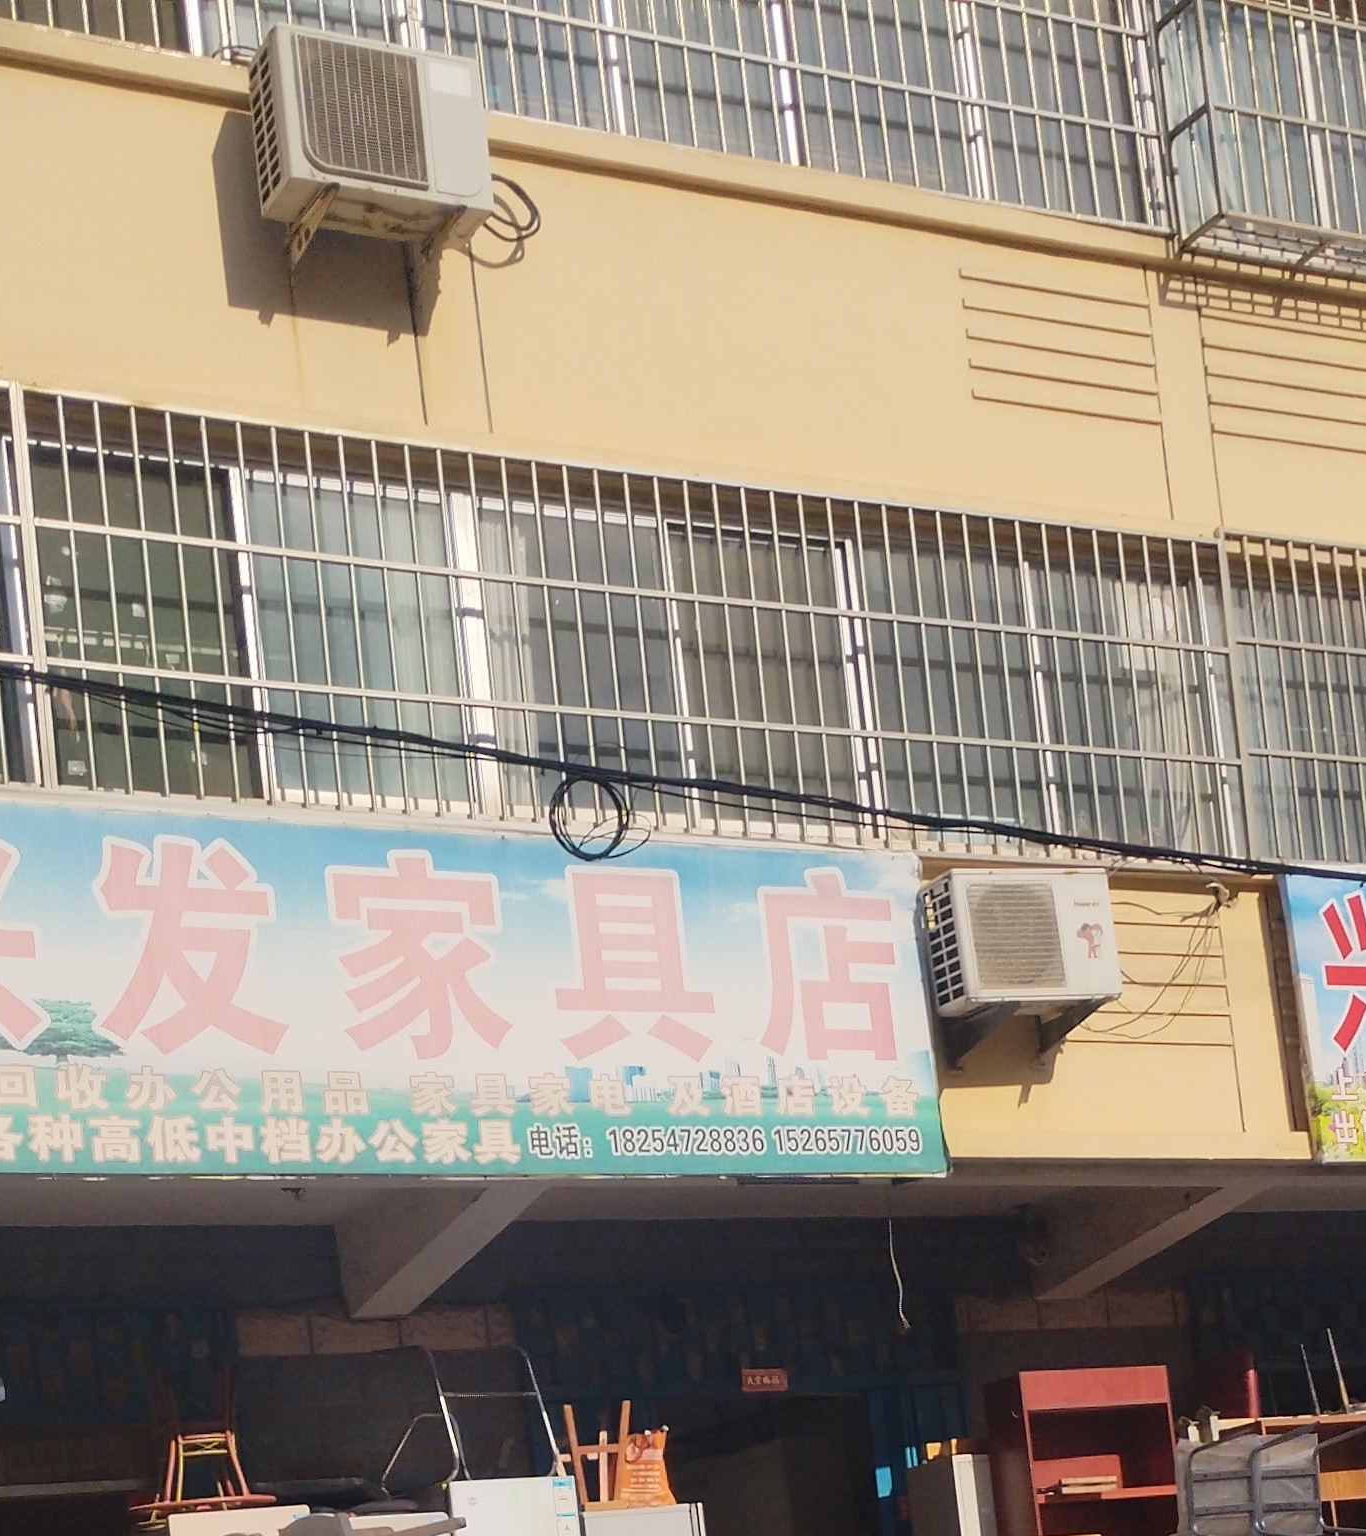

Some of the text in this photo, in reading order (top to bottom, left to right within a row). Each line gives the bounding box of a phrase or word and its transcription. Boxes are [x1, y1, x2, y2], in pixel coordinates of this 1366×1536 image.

[408, 1071, 632, 1118] 家具家电
[667, 1075, 920, 1120] 及酒店设备
[608, 1126, 766, 1158] 18254728836
[772, 1125, 922, 1157] 15265776059
